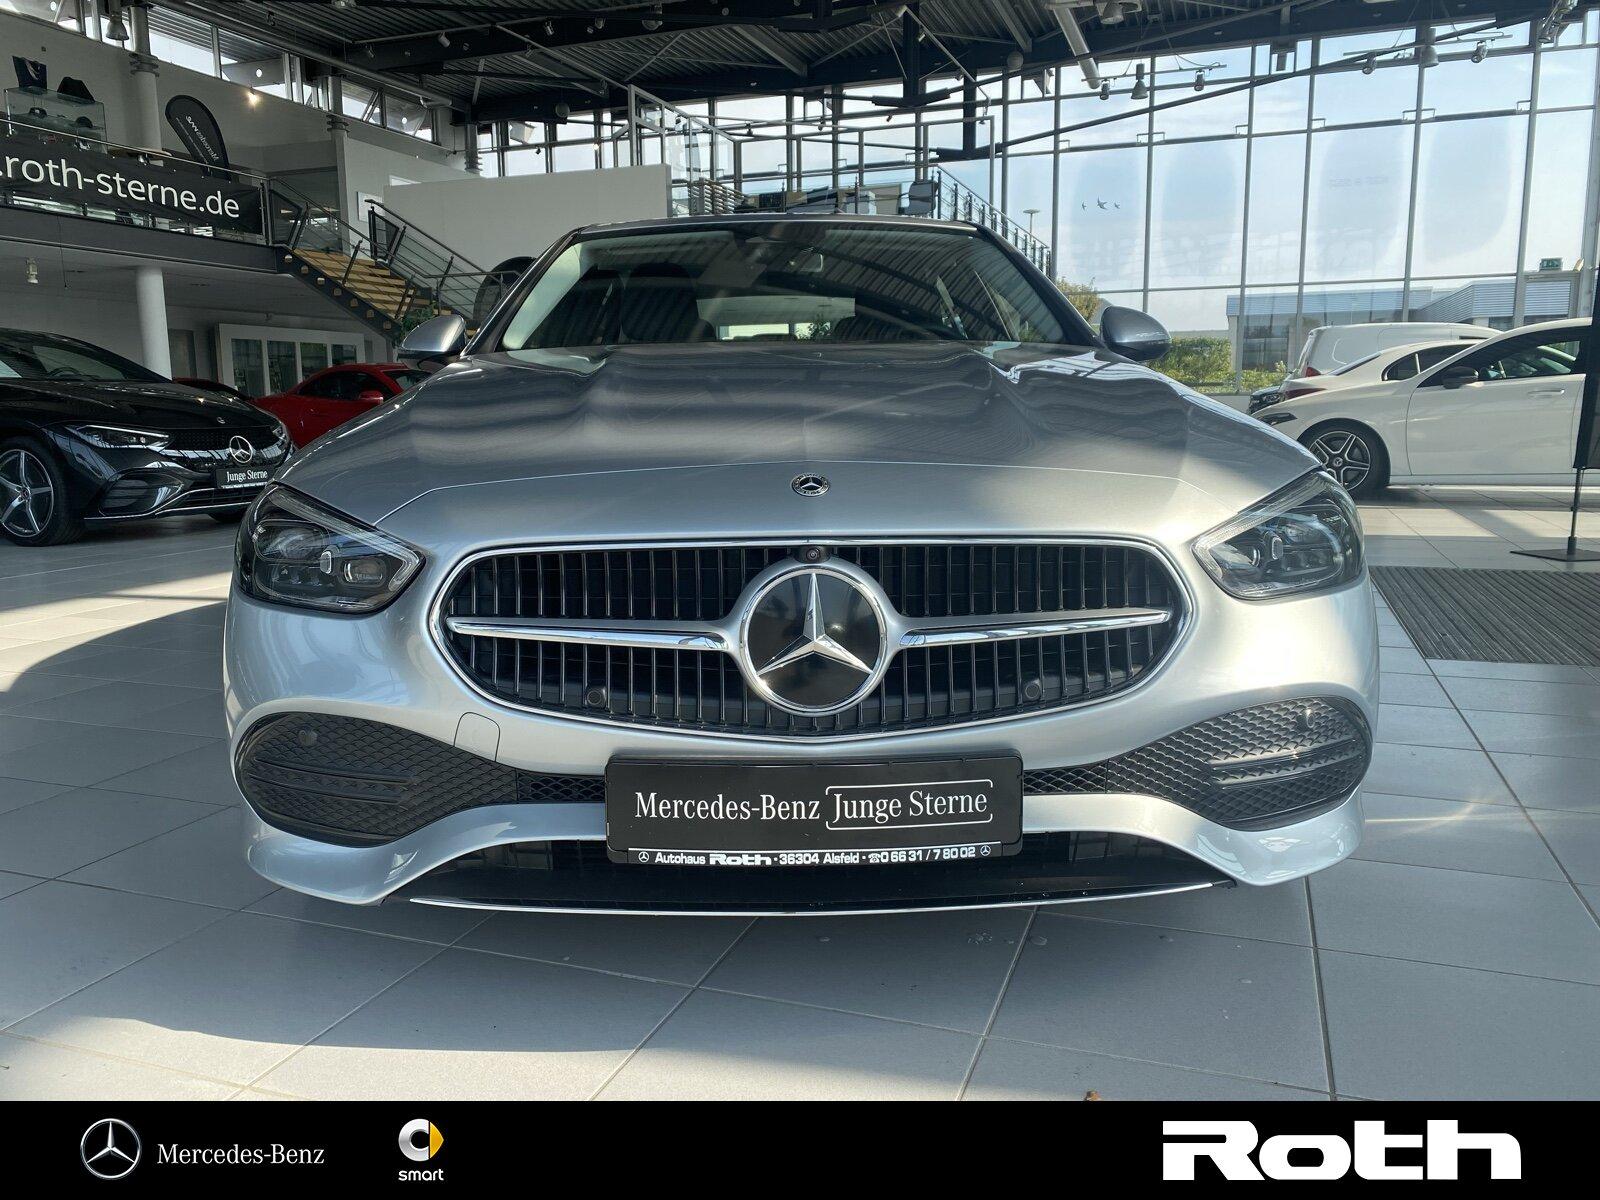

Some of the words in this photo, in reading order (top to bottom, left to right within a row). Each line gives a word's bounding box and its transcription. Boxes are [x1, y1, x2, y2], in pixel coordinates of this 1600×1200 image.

[226, 471, 247, 483] Junge
[247, 469, 268, 480] Sterne
[634, 792, 820, 820] Mercedes-Benz
[832, 793, 902, 824] Junge
[909, 790, 988, 817] Sterne
[654, 852, 706, 865] Autohaus
[709, 853, 772, 866] Roth
[779, 852, 820, 865] 36304
[822, 852, 860, 864] Alsfeld
